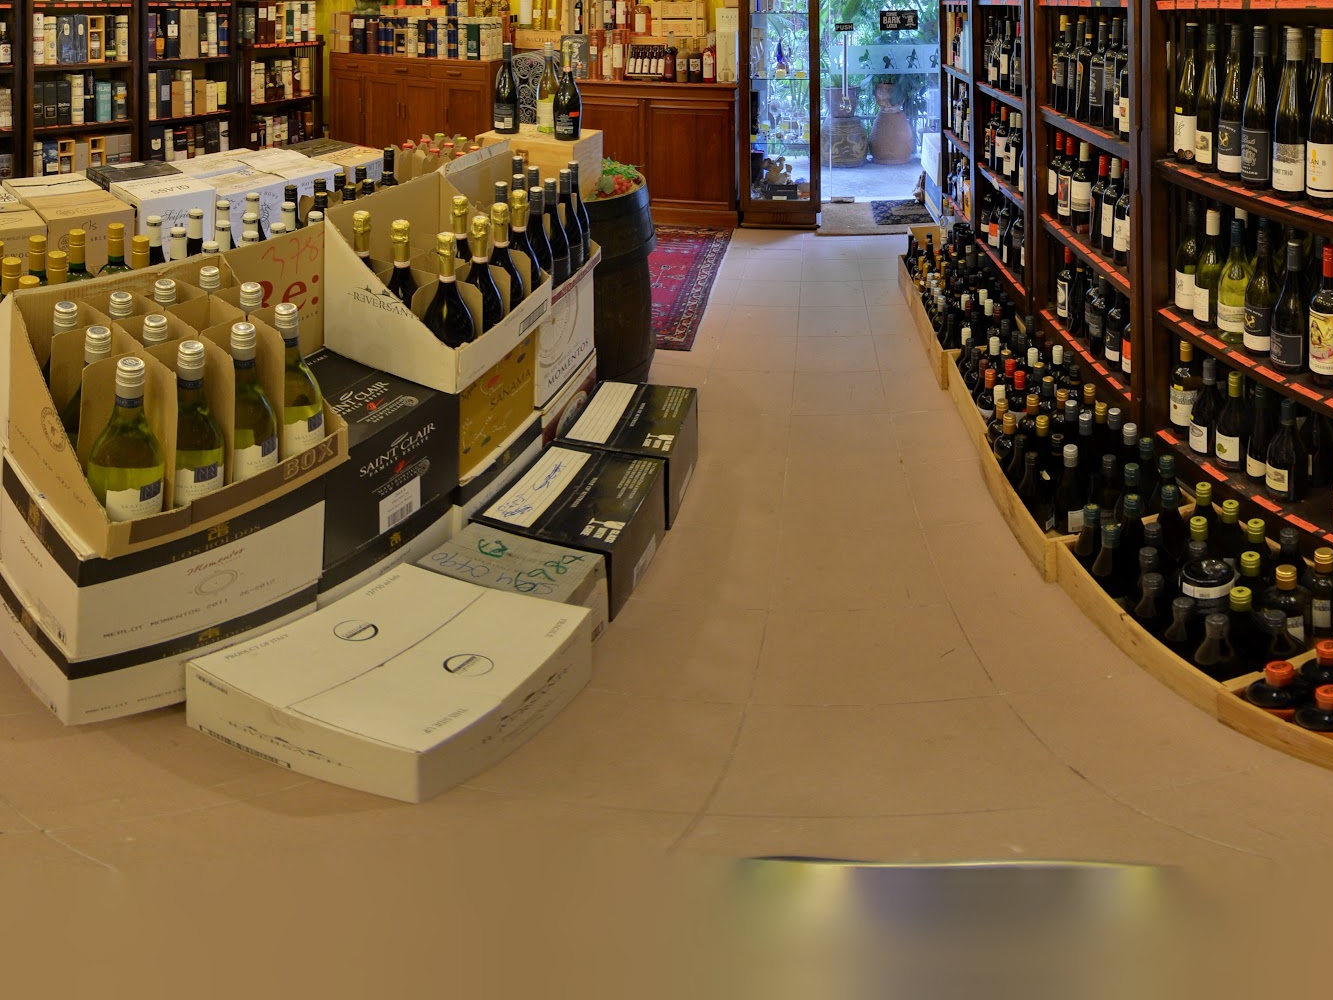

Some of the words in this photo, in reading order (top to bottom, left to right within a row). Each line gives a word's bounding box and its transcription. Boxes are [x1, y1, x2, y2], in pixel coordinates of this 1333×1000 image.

[835, 23, 853, 31] PUSH
[882, 16, 901, 25] BARK
[545, 338, 590, 388] MOMENTOS
[353, 380, 390, 402] CLAIR
[488, 368, 532, 411] SANAMA
[283, 437, 336, 481] BOX
[359, 446, 398, 478] SAINT
[398, 421, 437, 453] CLAIR
[369, 458, 400, 479] FAMILY
[402, 435, 431, 460] ESTATE
[204, 524, 263, 551] BOLDOS
[102, 624, 145, 639] MERLOT
[149, 607, 202, 628] MOMENTOS
